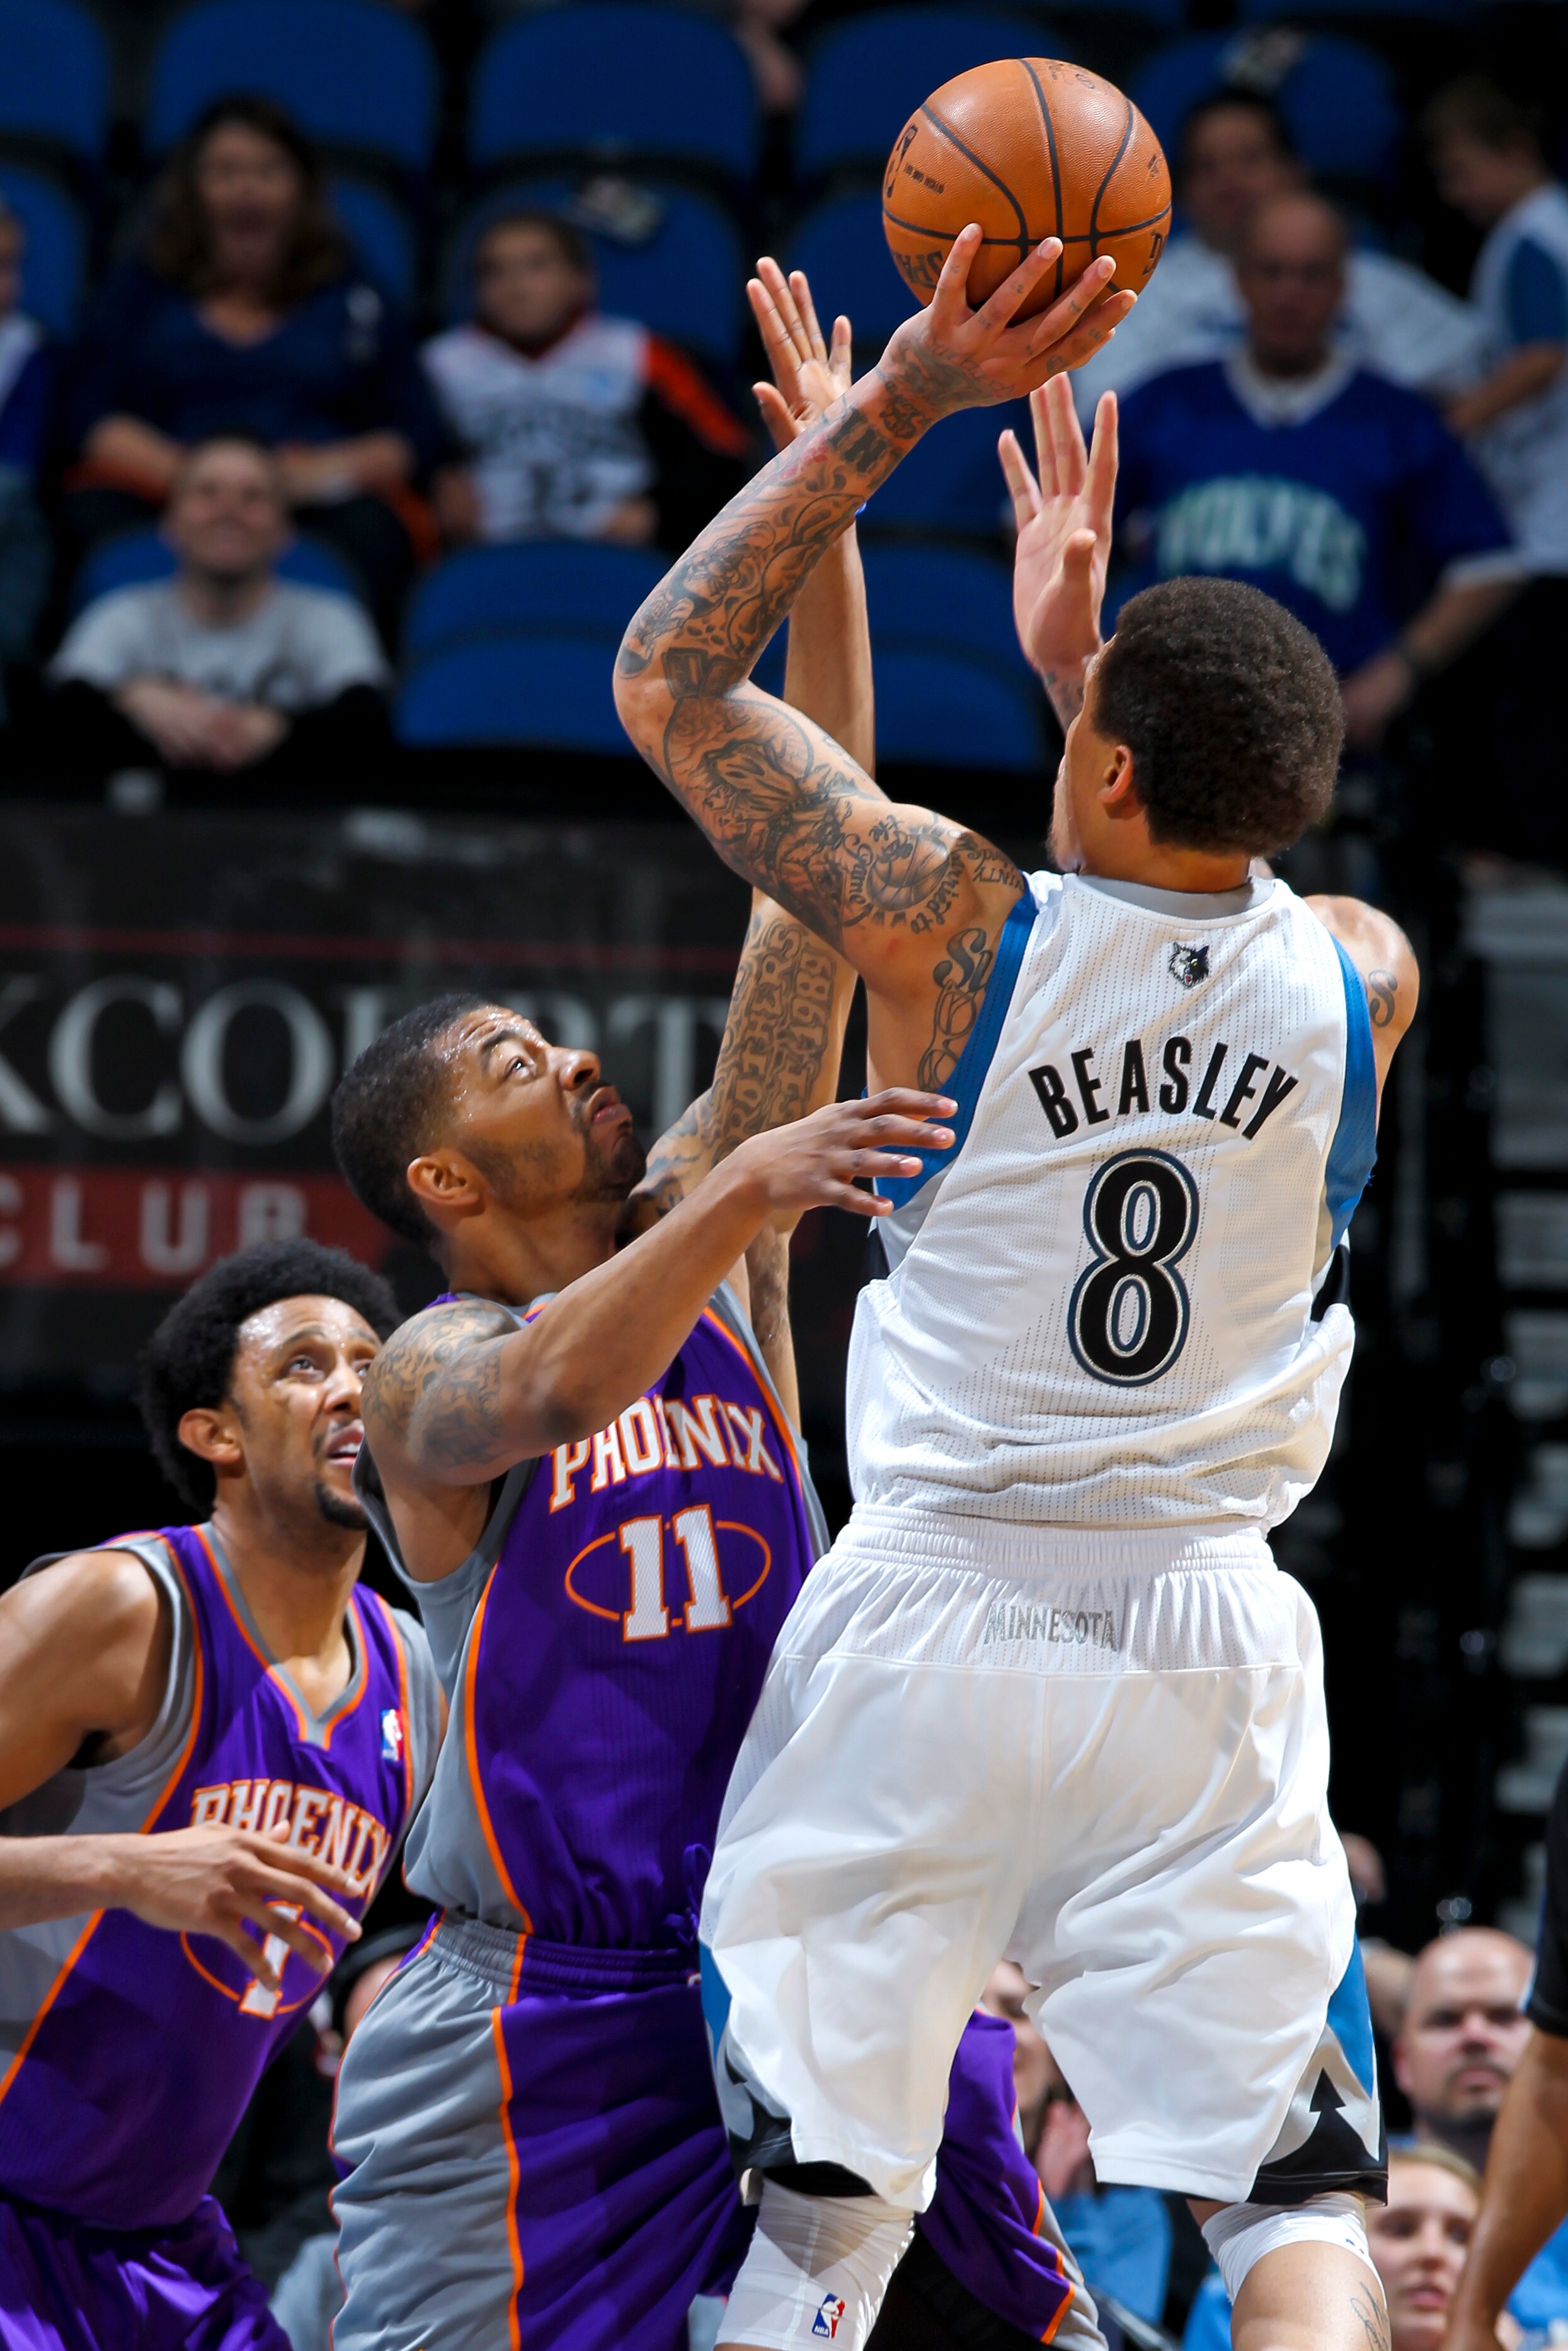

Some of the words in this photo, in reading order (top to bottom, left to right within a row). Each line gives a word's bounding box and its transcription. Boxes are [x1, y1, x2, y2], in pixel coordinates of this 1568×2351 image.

[1029, 1036, 1299, 1140] BEASLEY
[1067, 1148, 1199, 1387] 8
[619, 1504, 733, 1643] 11
[983, 1602, 1119, 1652] MINNESOTA
[191, 1778, 392, 1897] PHOENIX
